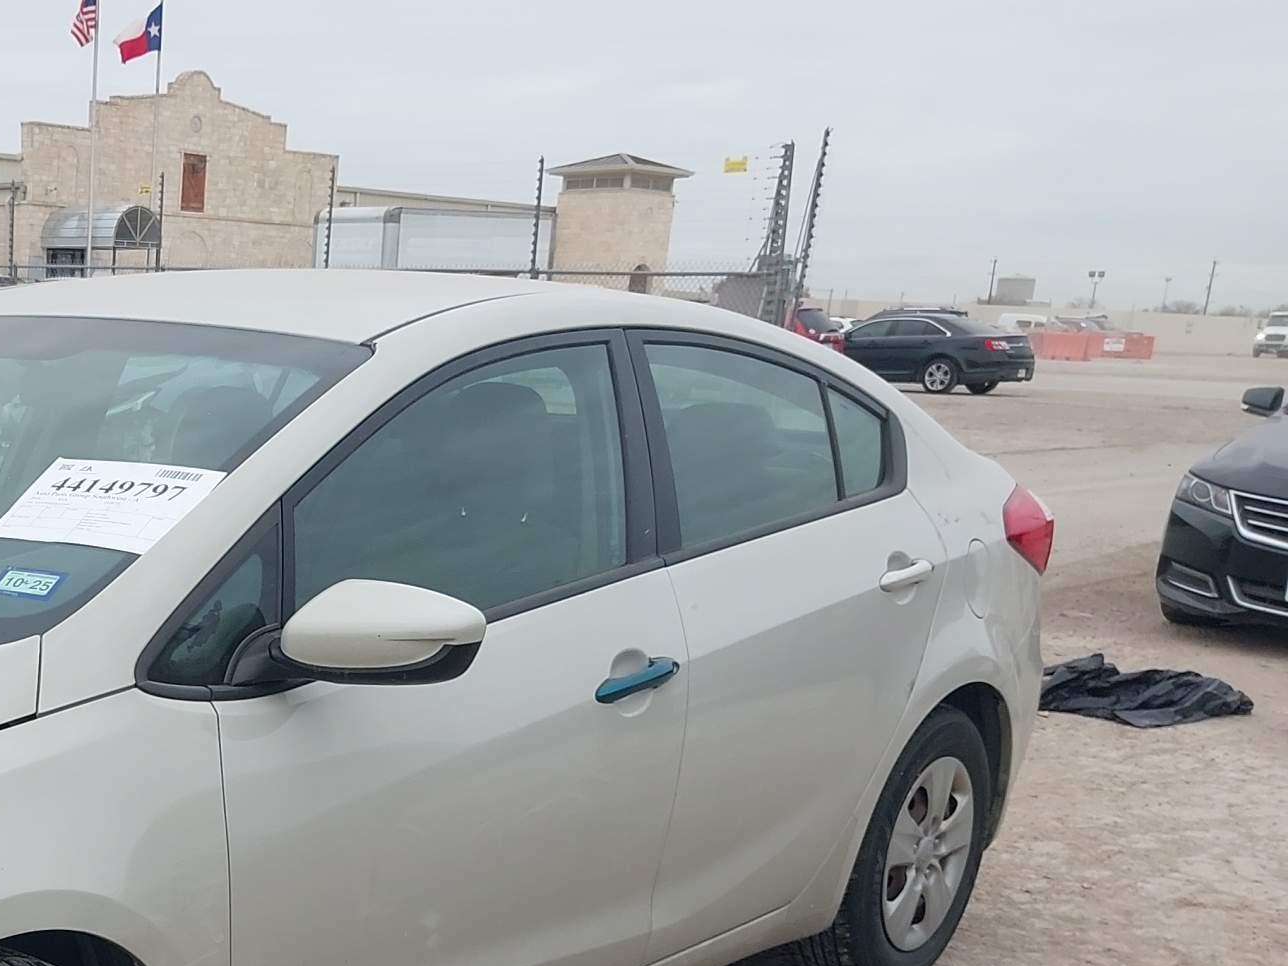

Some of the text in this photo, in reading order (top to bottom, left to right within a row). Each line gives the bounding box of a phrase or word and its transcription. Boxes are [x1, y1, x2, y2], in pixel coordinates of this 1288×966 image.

[51, 476, 188, 502] 44149797
[4, 575, 25, 588] 10
[28, 579, 53, 592] 25
